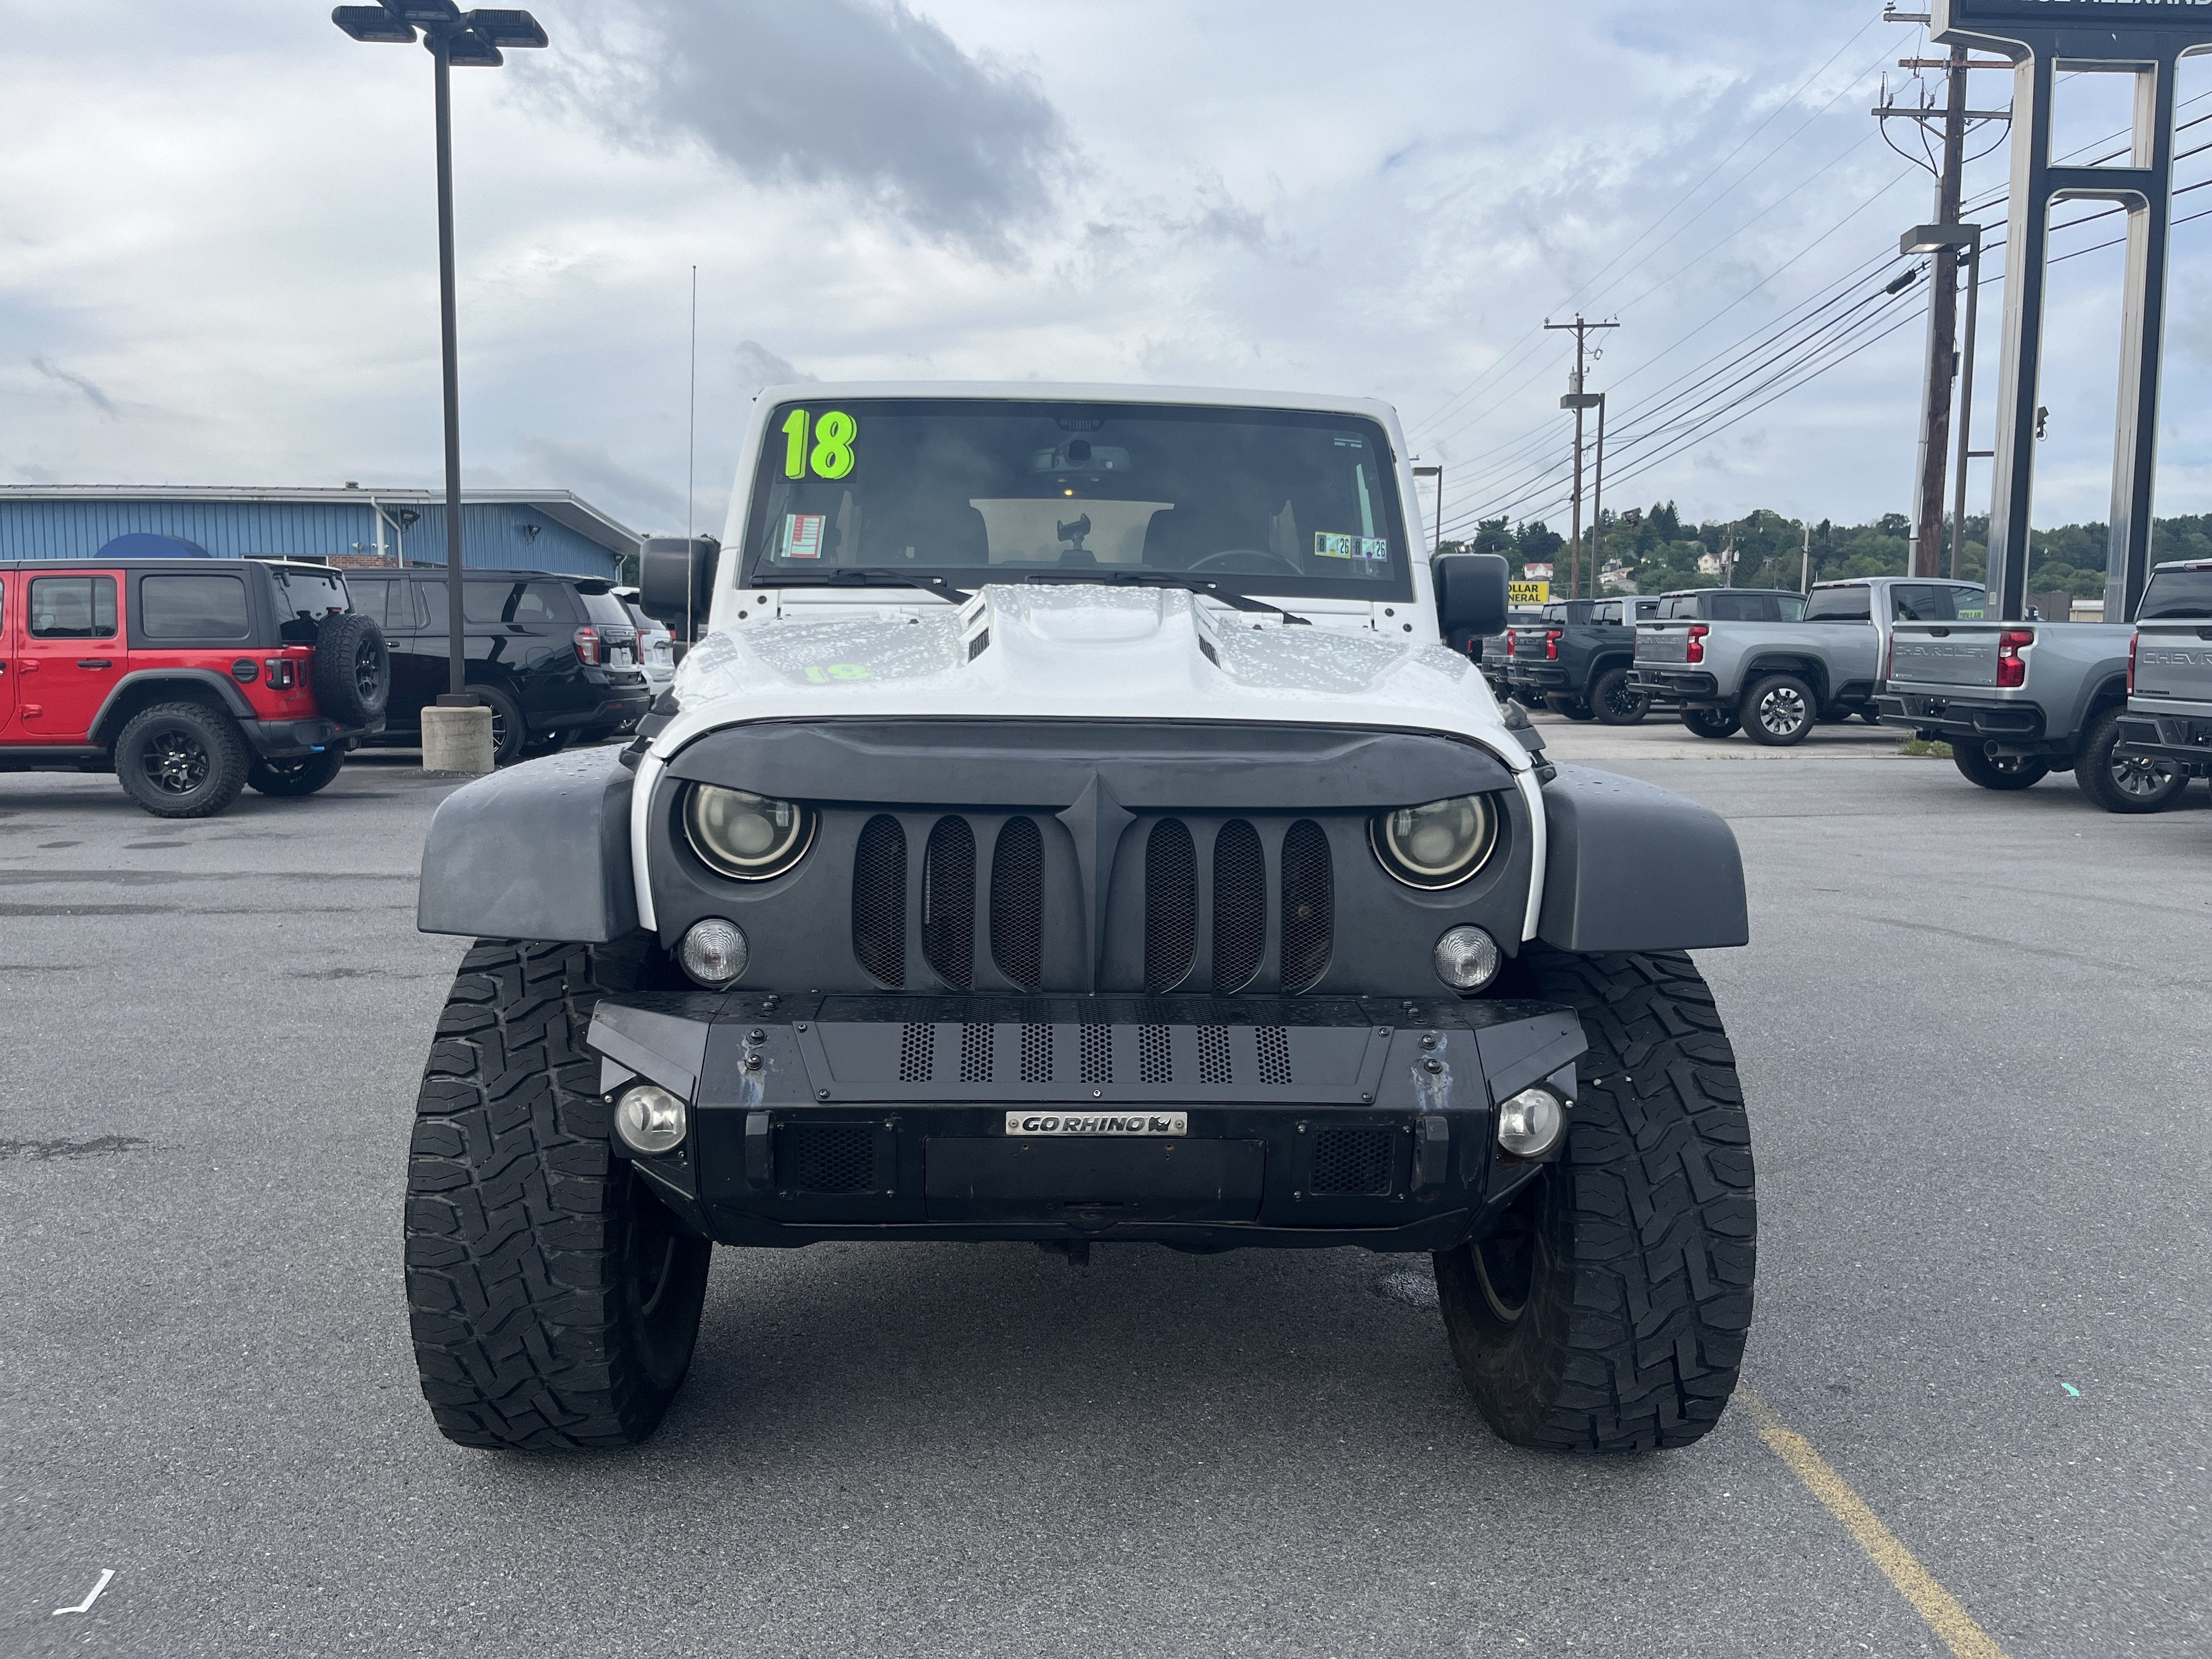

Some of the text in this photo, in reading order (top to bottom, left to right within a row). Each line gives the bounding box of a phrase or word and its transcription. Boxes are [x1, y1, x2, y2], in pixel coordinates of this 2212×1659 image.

[781, 409, 858, 480] 18
[1319, 538, 1349, 554] 8 26
[1355, 541, 1385, 557] 8 26
[1895, 646, 1989, 658] CHEVROLET
[1022, 1115, 1147, 1132] GO RHINO
